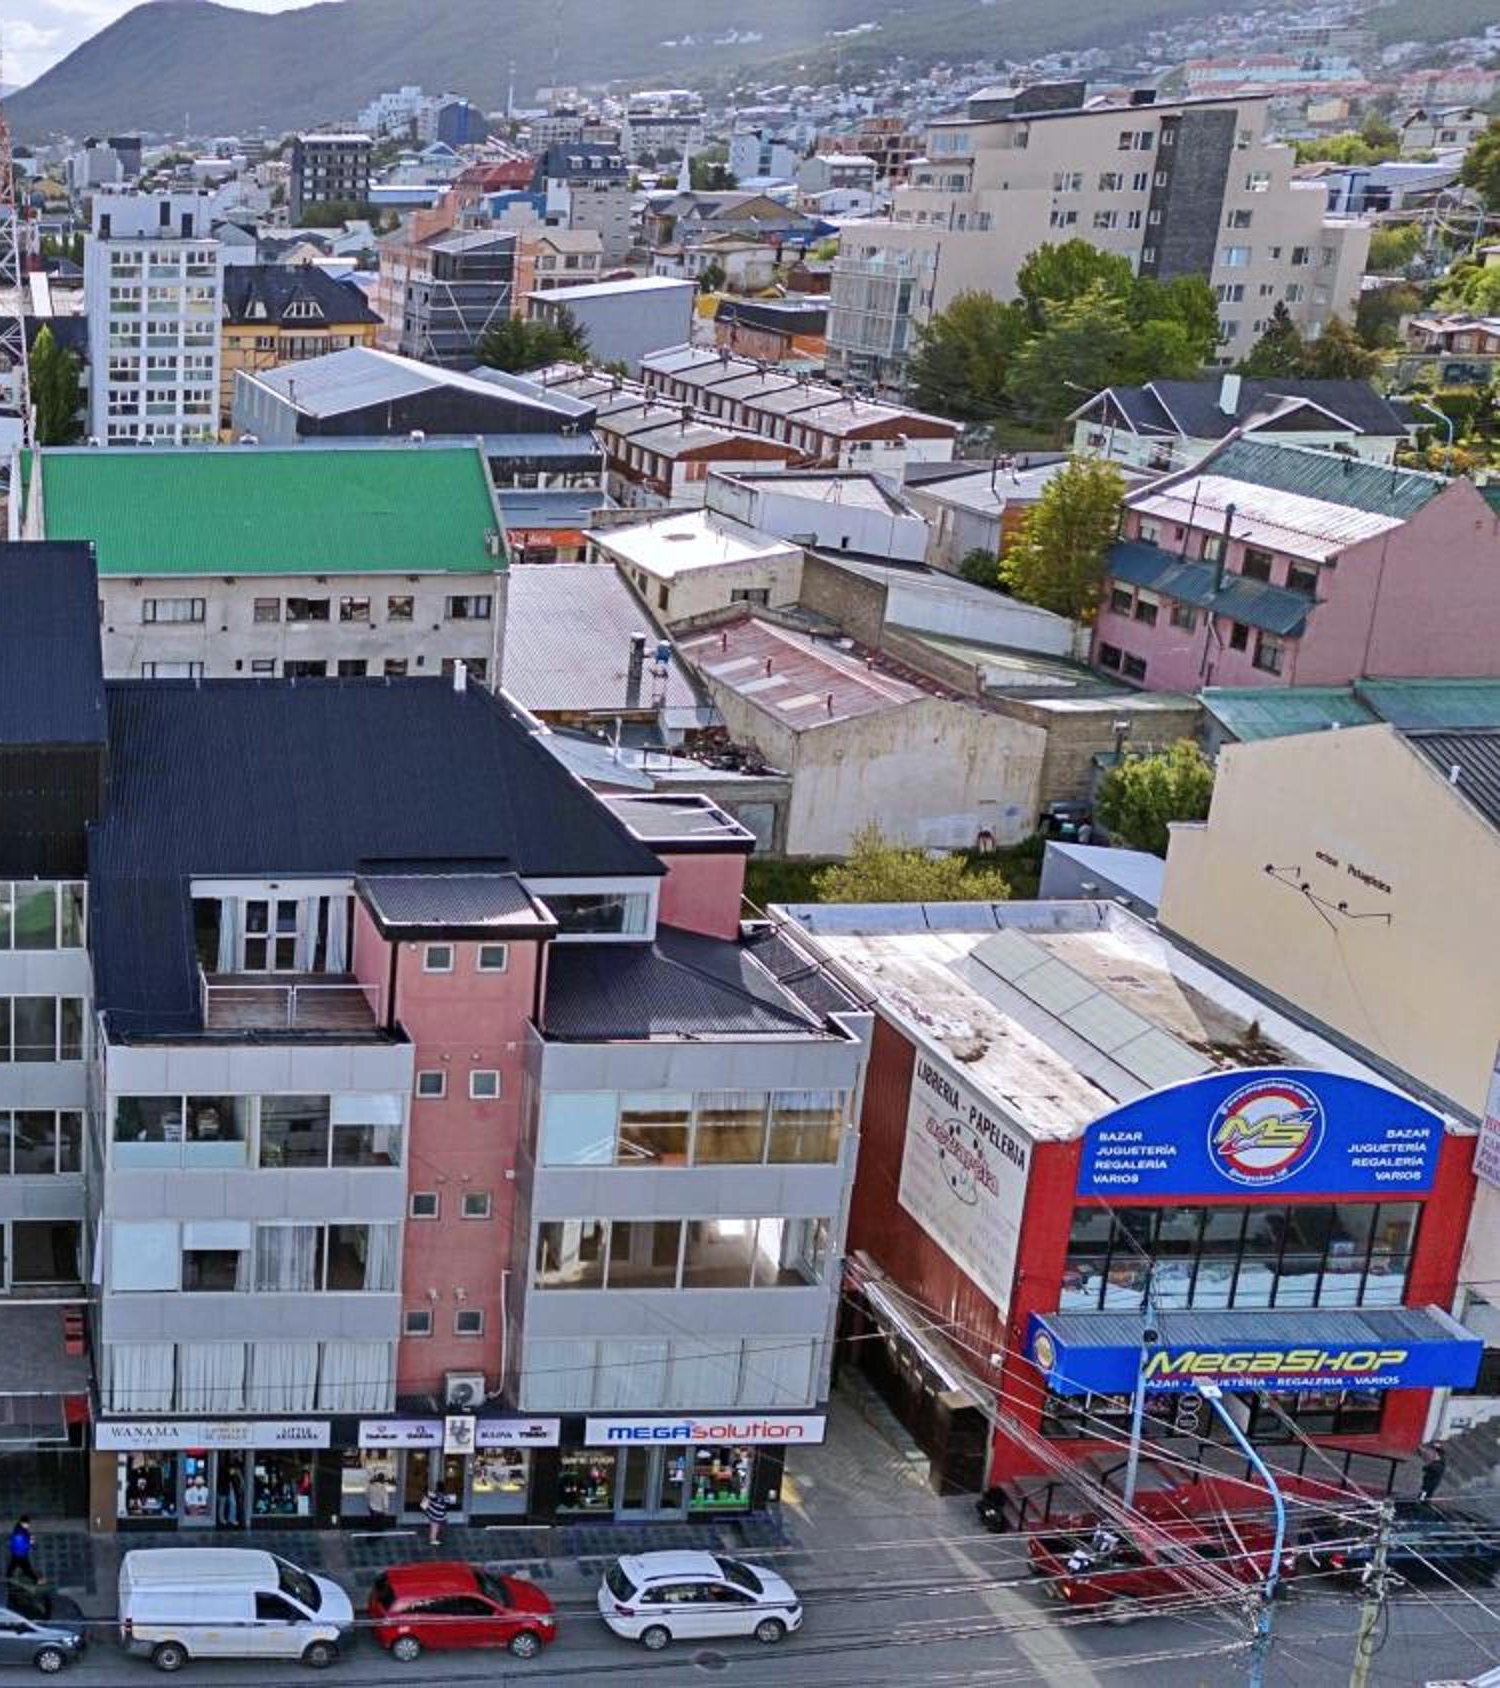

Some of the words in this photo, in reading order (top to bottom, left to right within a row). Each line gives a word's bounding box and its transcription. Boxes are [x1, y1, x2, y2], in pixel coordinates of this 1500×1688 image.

[968, 1104, 1026, 1172] PAPELERIA
[1099, 1131, 1143, 1142] BAZAR
[1385, 1128, 1431, 1139] BAZAR
[1096, 1144, 1177, 1156] JUGUETERÍA
[1347, 1142, 1427, 1153] JUGUETERÍA
[1092, 1173, 1140, 1184] VARIOS
[1375, 1171, 1422, 1181] VARIOS
[1355, 1375, 1400, 1385] VARIOS
[110, 1426, 180, 1438] WANAMA
